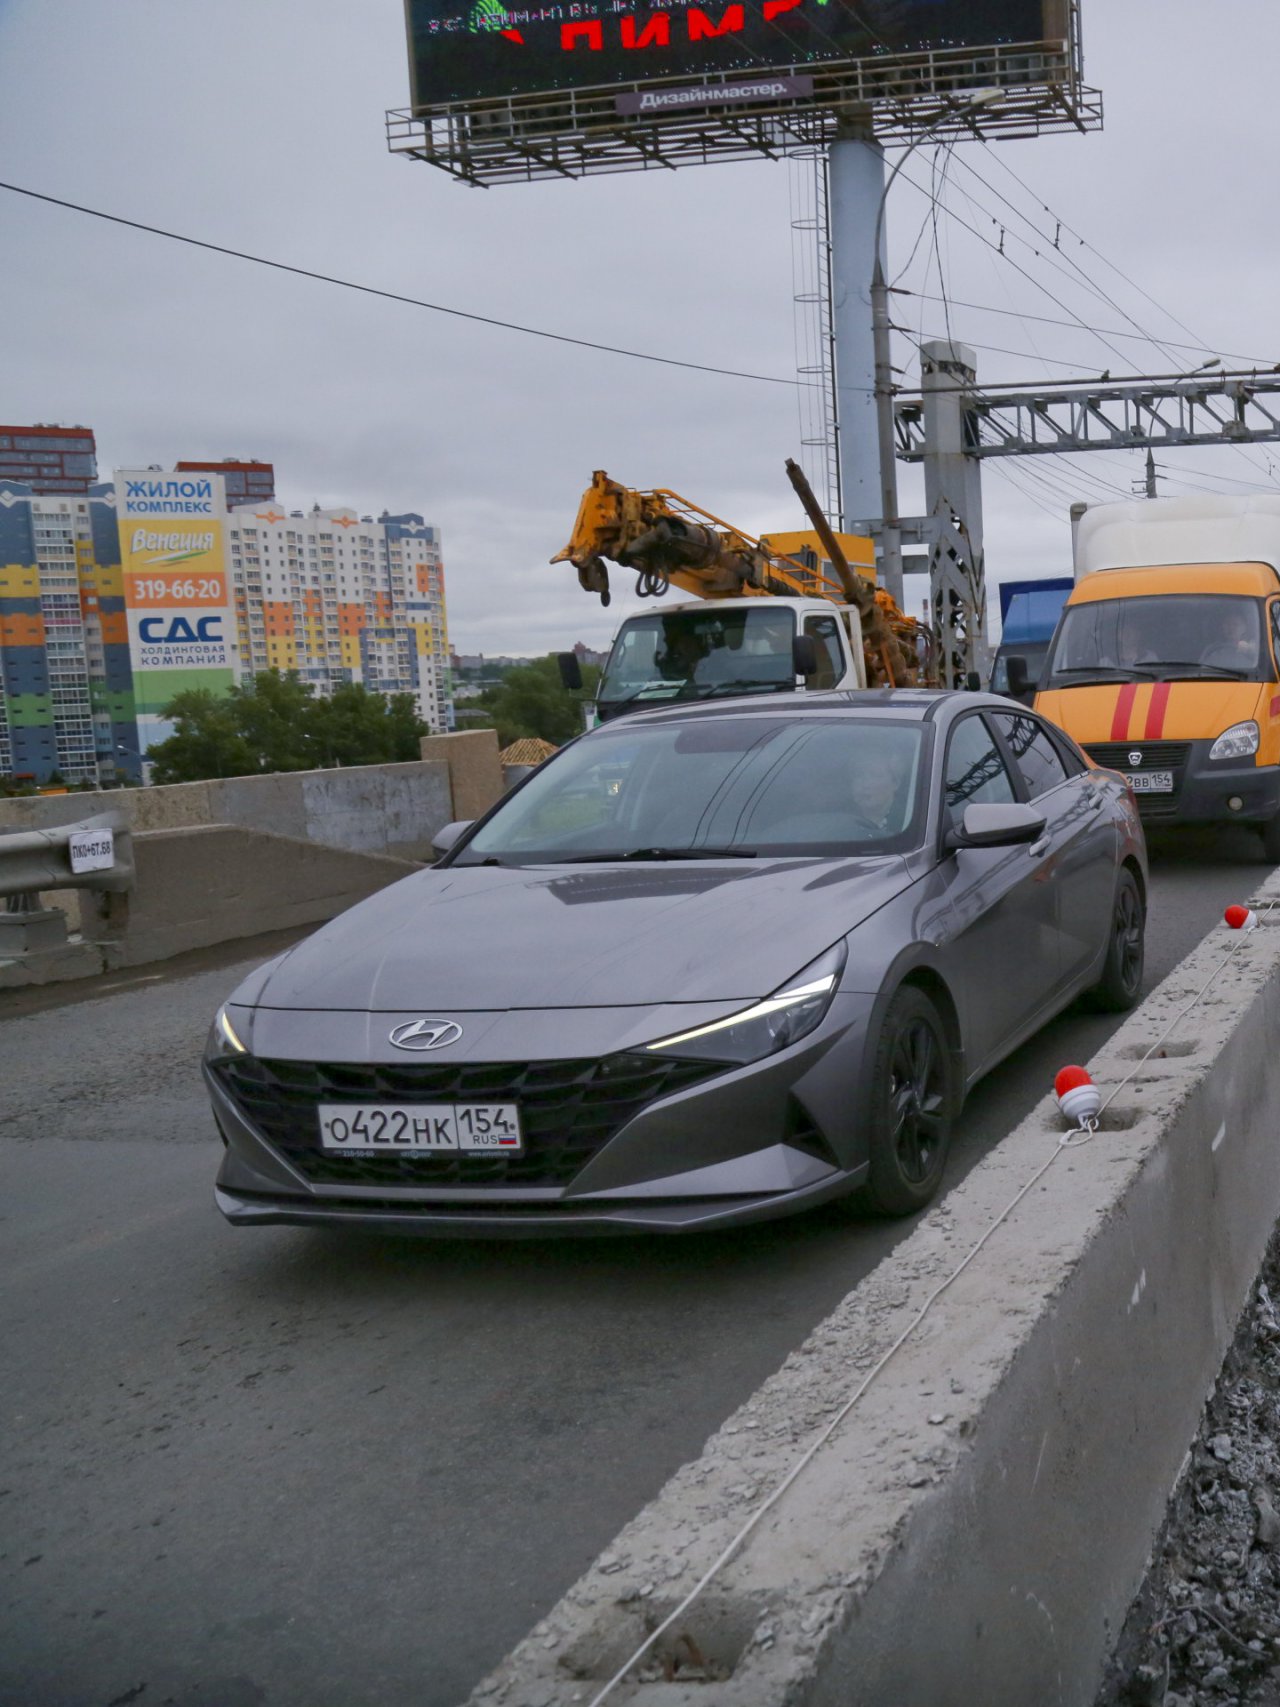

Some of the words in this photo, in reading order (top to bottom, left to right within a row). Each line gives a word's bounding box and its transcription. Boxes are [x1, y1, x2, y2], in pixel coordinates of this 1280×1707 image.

[640, 82, 788, 110] Дизайнмастер.
[125, 480, 212, 498] ЖИЛОЙ
[126, 501, 212, 513] КОМПЛЕКС
[130, 529, 214, 554] Венеция
[134, 579, 221, 600] 319-66-20
[141, 645, 225, 655] ХОЛДИНГОВАЯ
[141, 654, 226, 666] КОМПАНИЯ
[1151, 774, 1170, 784] 154
[330, 1110, 452, 1144] О422НК
[459, 1108, 510, 1134] 154
[472, 1136, 498, 1145] RUS
